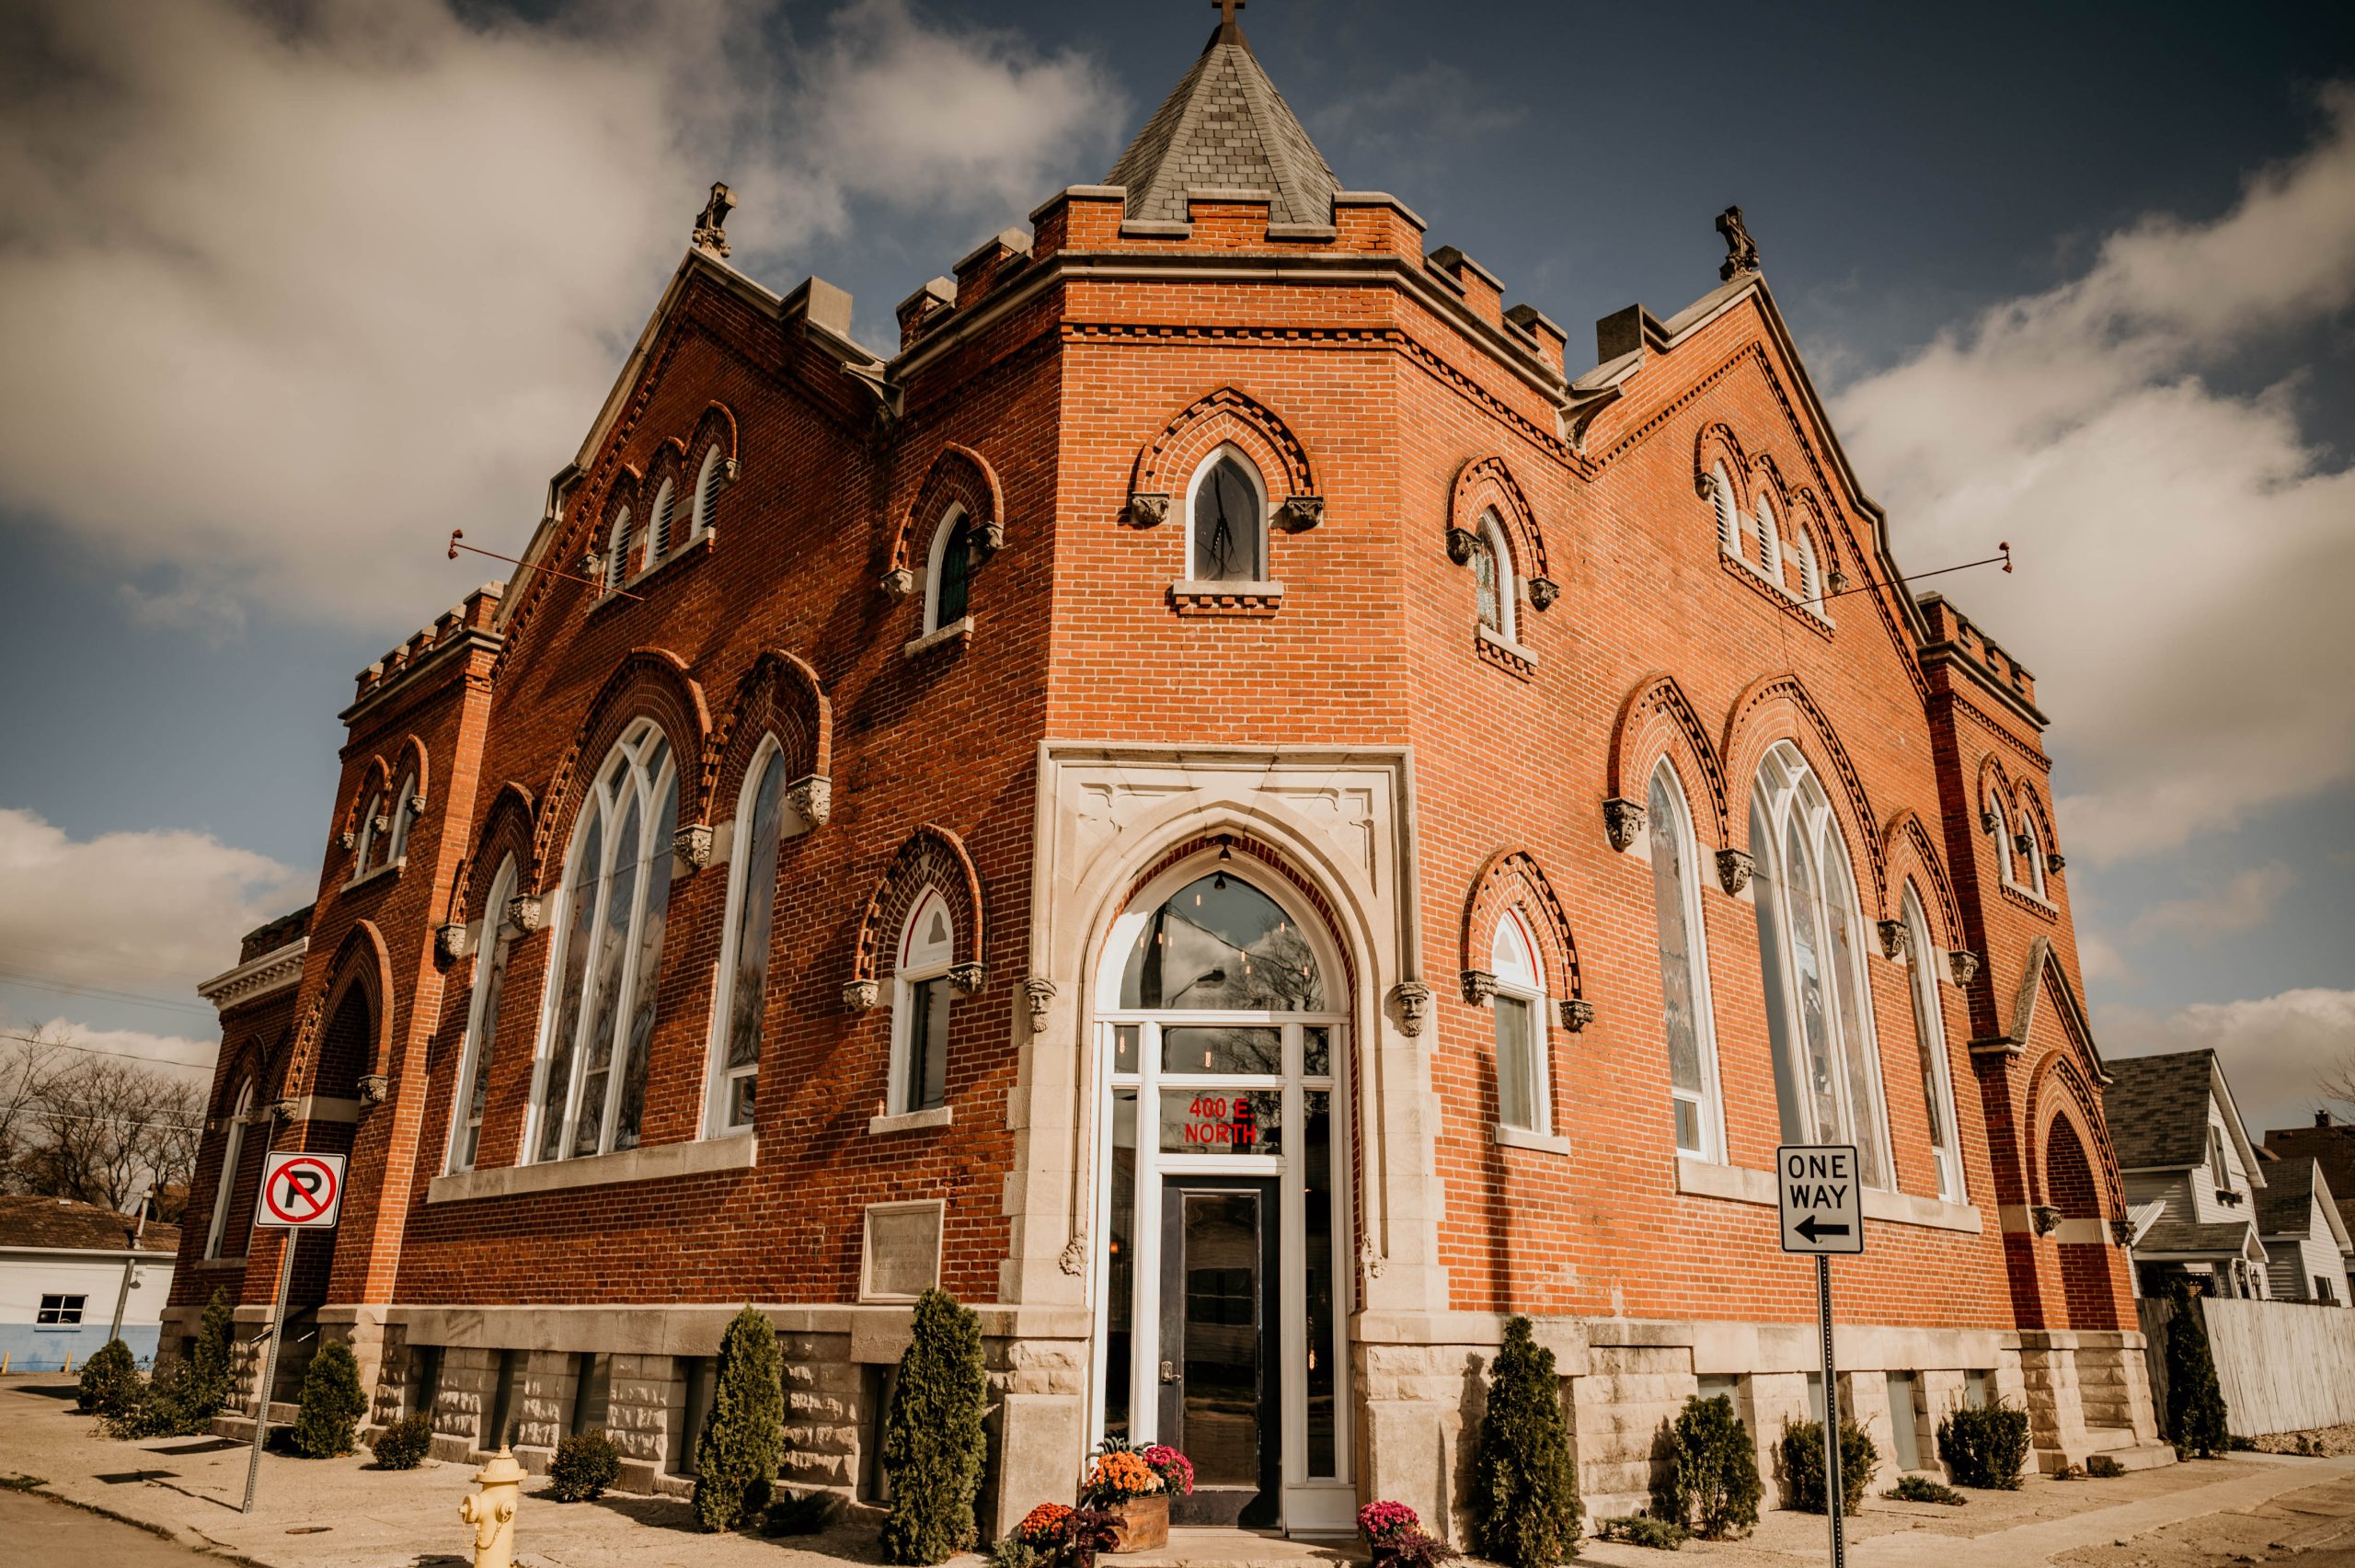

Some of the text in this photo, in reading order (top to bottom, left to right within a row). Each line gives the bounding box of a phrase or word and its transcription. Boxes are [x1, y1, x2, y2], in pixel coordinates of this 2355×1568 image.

[1189, 1097, 1255, 1119] 400 E.
[1185, 1123, 1257, 1144] NORTH
[1788, 1155, 1848, 1179] ONE
[284, 1170, 323, 1208] P
[1789, 1185, 1848, 1208] WAY
